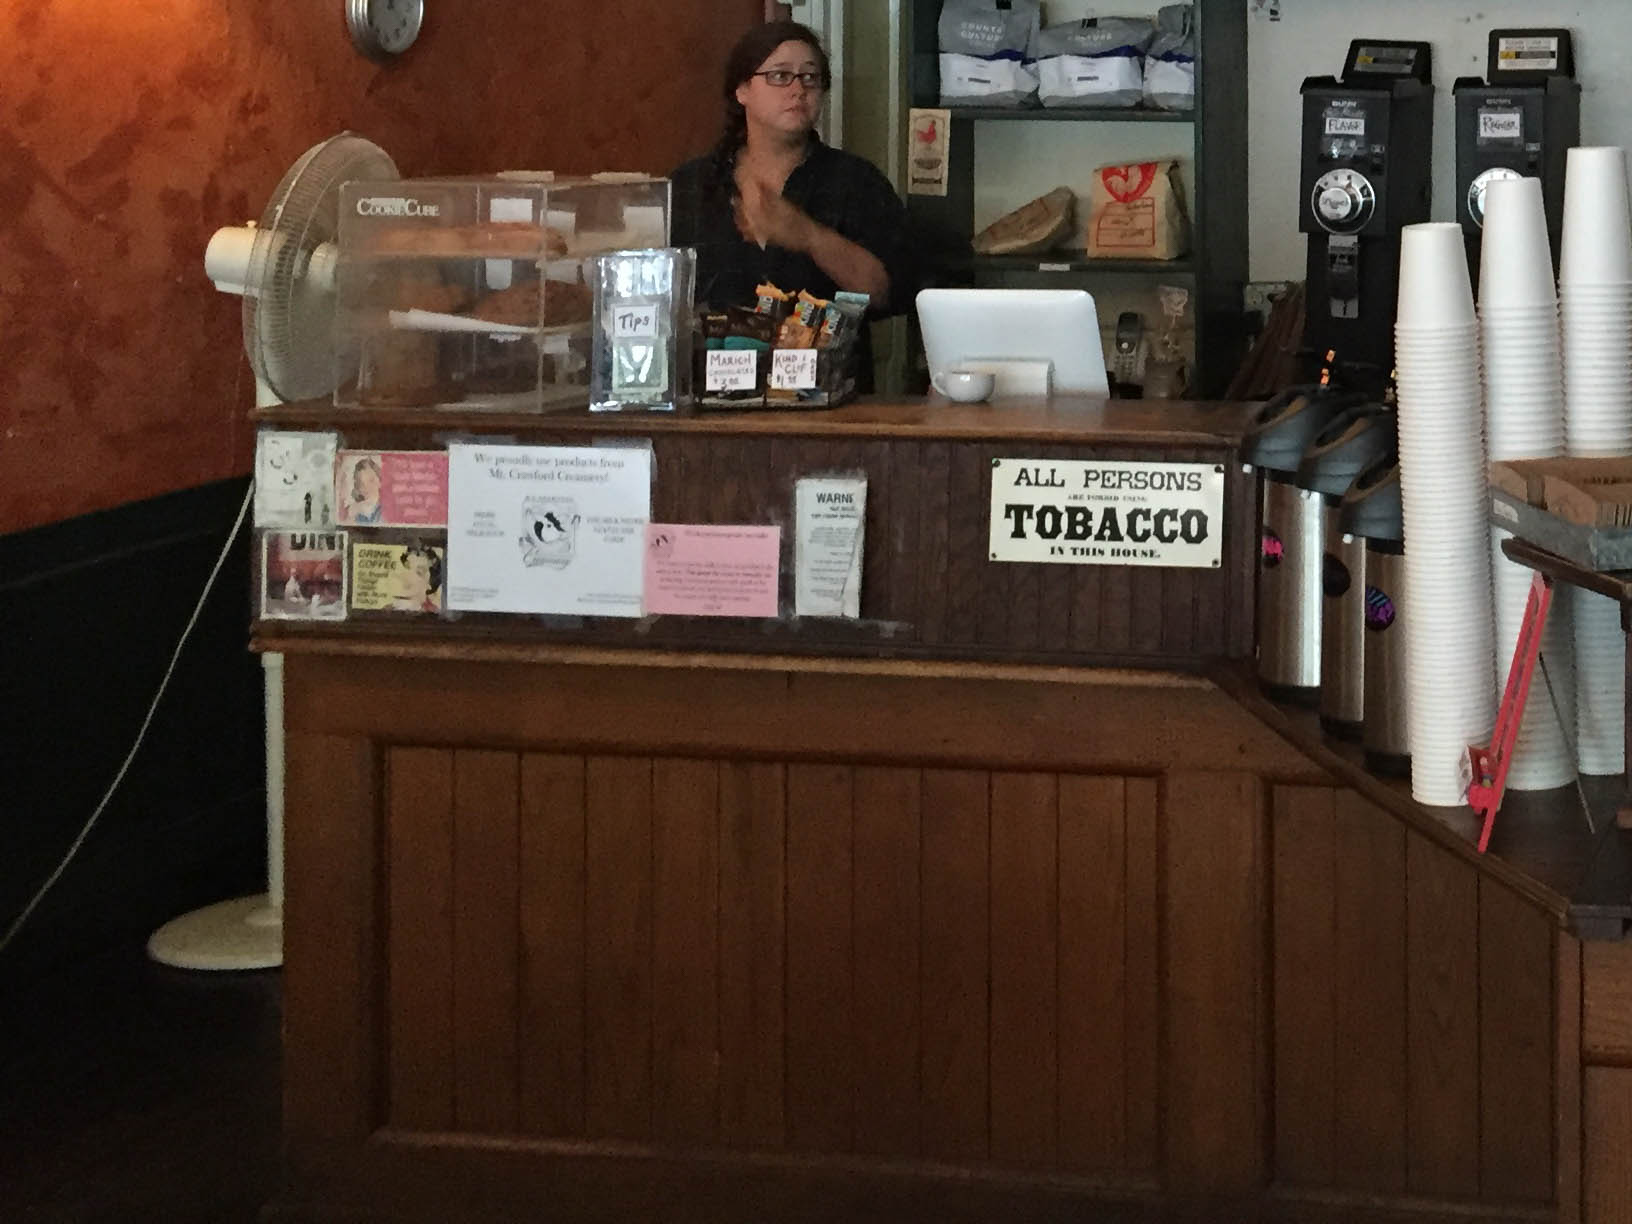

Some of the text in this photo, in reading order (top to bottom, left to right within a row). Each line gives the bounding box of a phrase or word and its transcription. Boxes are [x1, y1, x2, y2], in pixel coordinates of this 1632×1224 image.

[1014, 467, 1203, 492] ALL PERSONS
[1004, 503, 1210, 544] TOBACCO
[1050, 546, 1064, 556] IN
[1070, 546, 1105, 558] THIS
